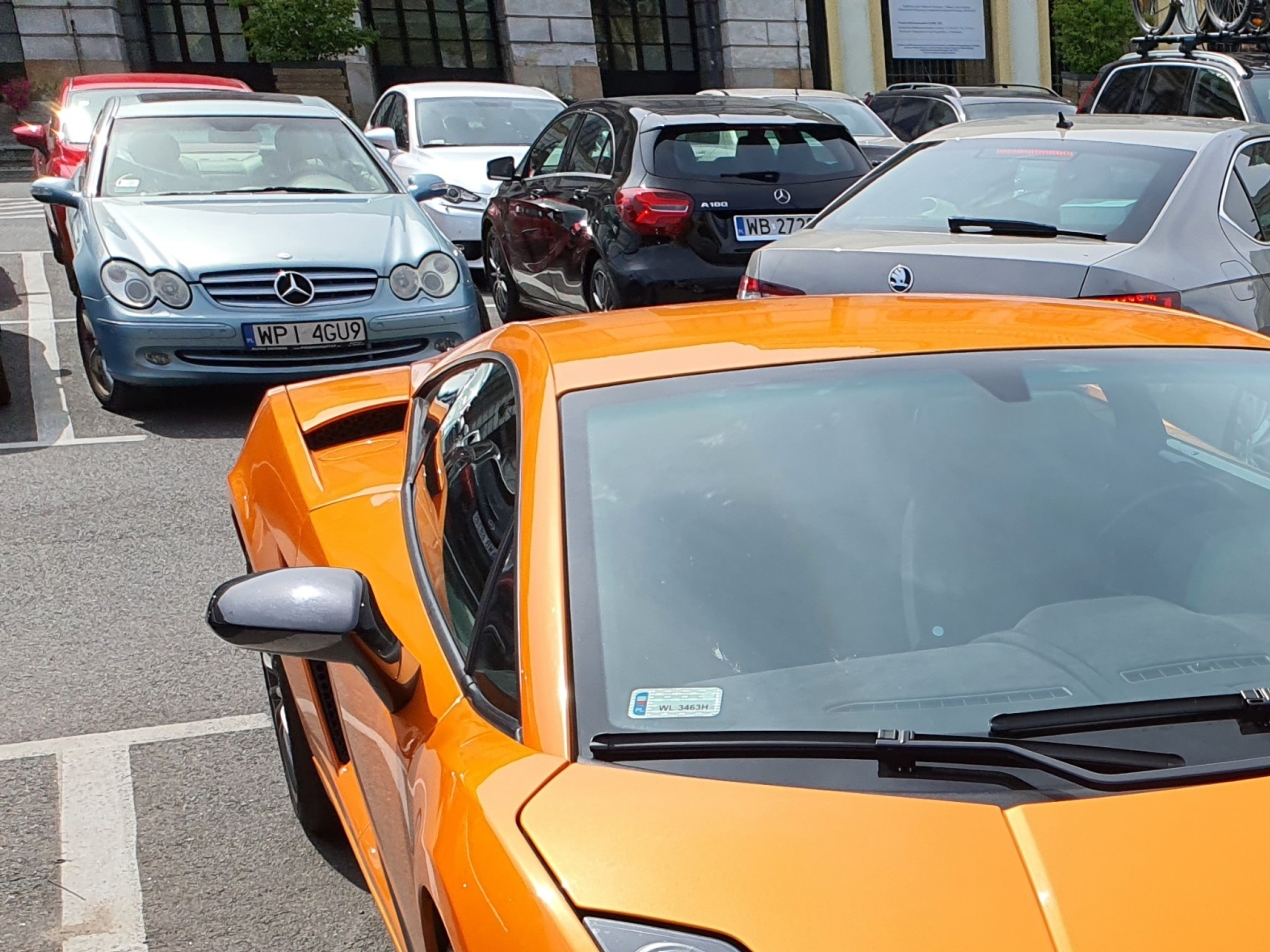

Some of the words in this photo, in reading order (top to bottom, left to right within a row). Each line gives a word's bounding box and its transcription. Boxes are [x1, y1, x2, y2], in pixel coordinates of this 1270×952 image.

[746, 218, 771, 235] WB
[776, 217, 814, 235] 272
[312, 321, 361, 343] 4GU9
